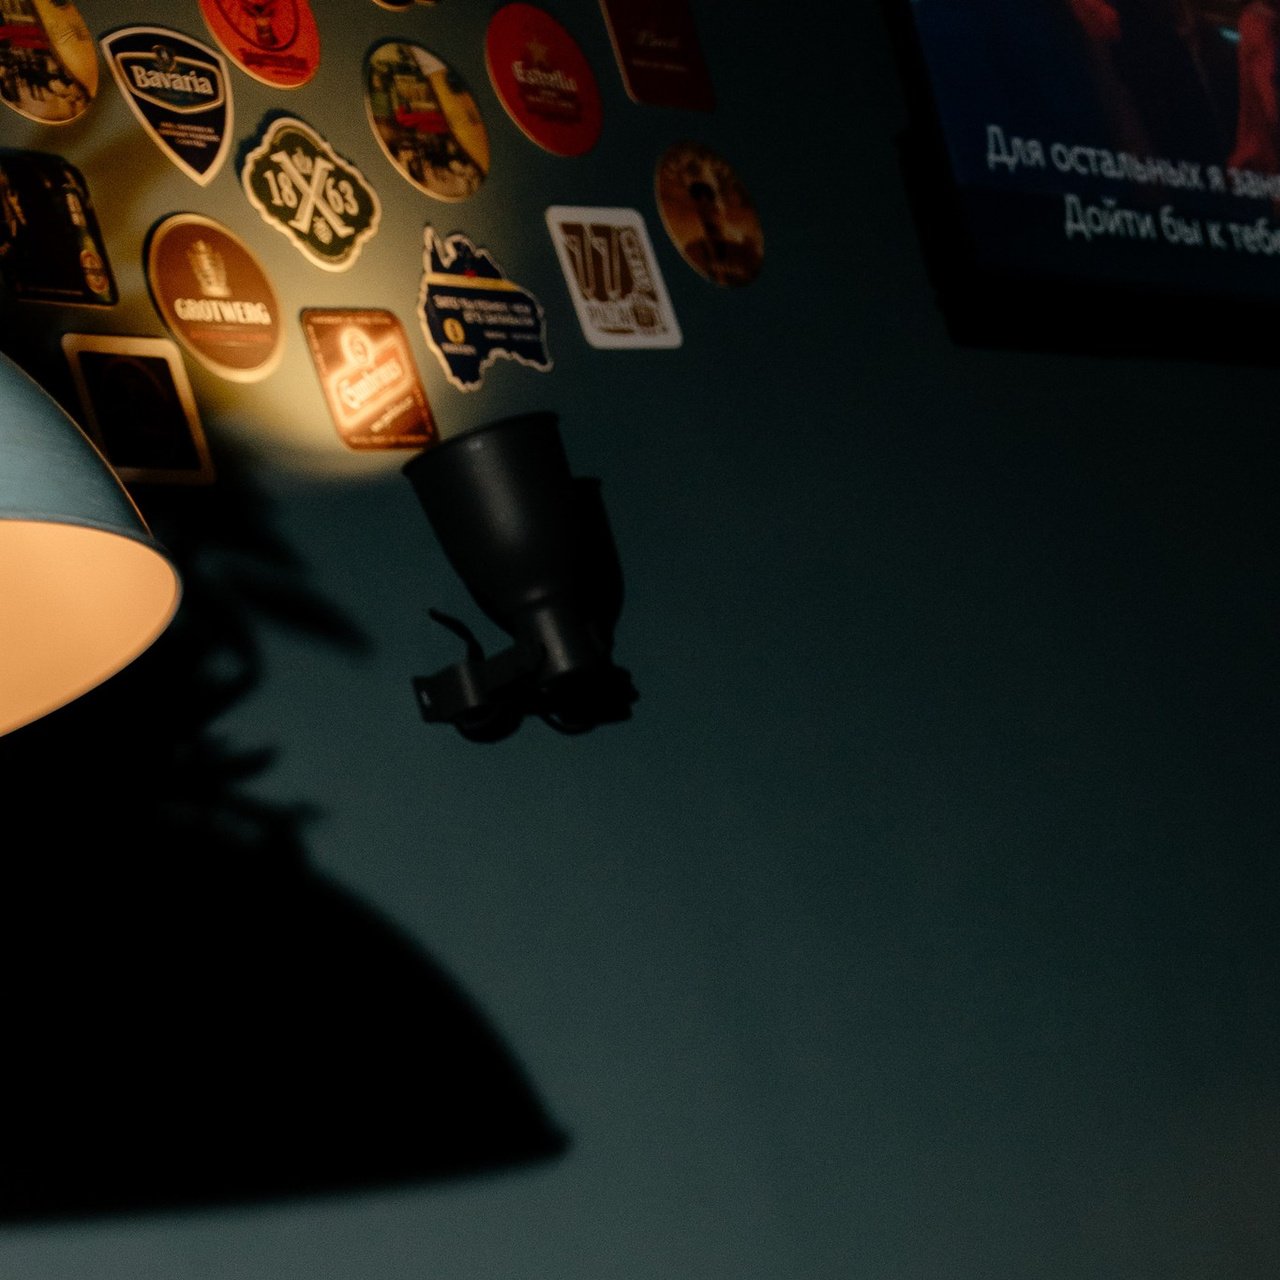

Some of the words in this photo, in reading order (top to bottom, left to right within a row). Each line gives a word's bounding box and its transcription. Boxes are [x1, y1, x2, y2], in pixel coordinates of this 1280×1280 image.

[130, 65, 214, 95] Bavaria
[986, 123, 1046, 173] Для
[1050, 142, 1205, 192] остальных
[1207, 165, 1227, 192] я
[1064, 192, 1157, 242] Дойти
[1160, 205, 1204, 246] бы
[1207, 220, 1228, 250] к
